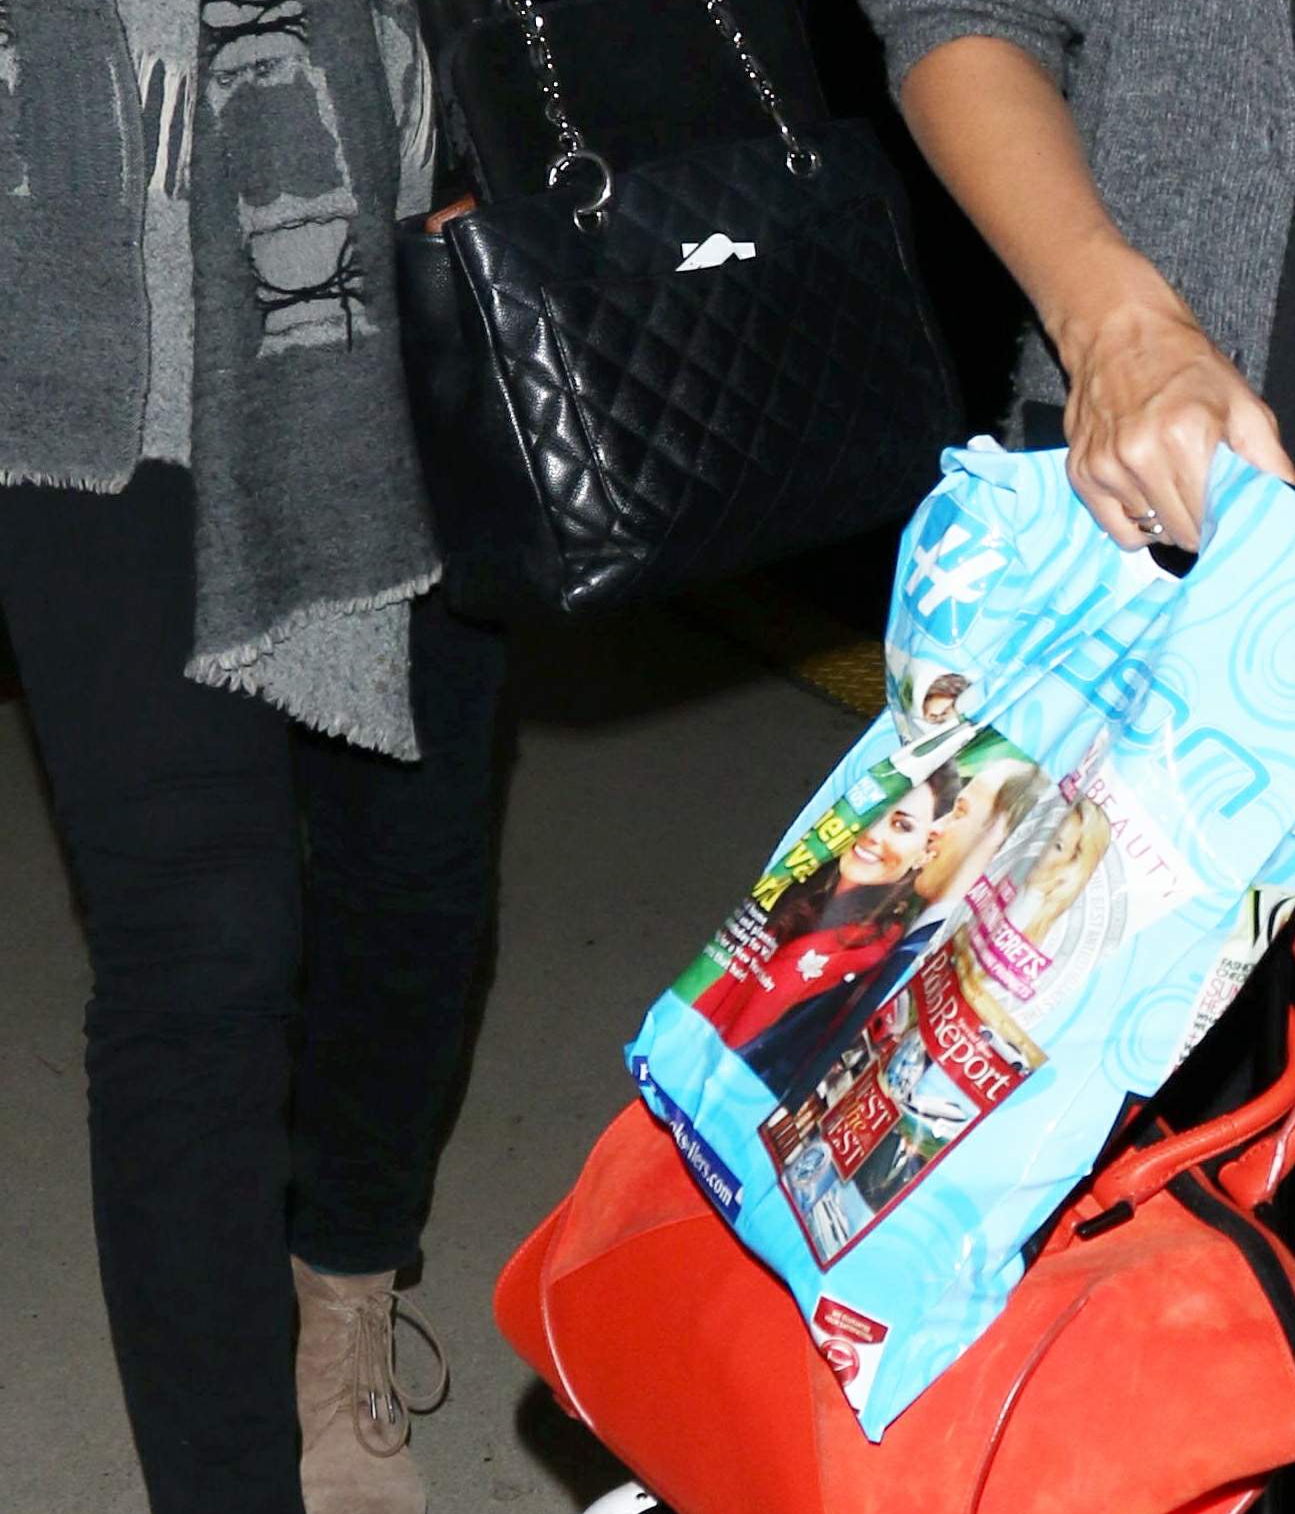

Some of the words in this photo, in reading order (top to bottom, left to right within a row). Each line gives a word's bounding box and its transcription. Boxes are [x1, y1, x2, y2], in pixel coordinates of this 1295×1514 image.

[1086, 777, 1177, 898] BEAUTY
[994, 922, 1048, 980] ECRETS
[929, 994, 1010, 1102] Report
